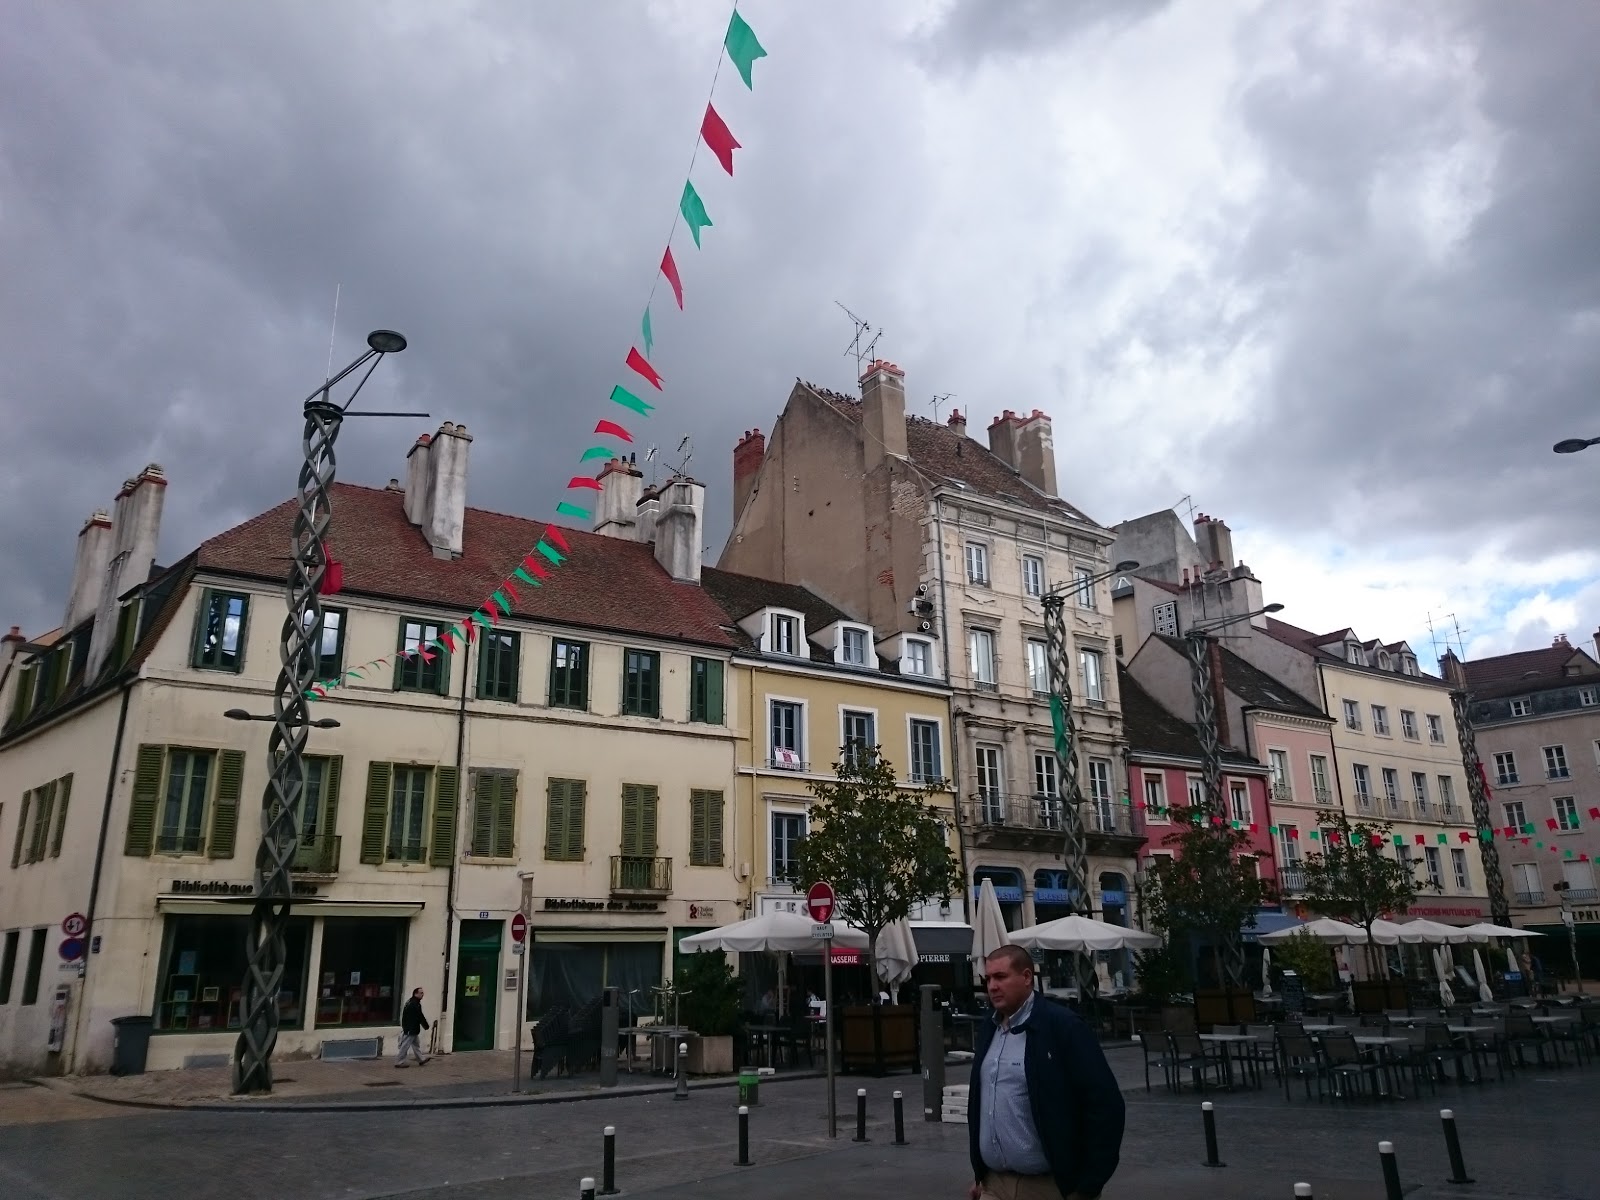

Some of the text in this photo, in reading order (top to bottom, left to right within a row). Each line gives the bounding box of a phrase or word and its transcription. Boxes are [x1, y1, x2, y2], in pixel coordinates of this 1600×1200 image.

[172, 880, 254, 893] Bibliothèque
[1038, 891, 1068, 901] BRASSE
[544, 898, 658, 911] Bibliothèque des Jeunes
[1408, 907, 1441, 917] OPTICIENS
[830, 954, 858, 964] RASSERIE
[920, 954, 950, 962] PIERRE
